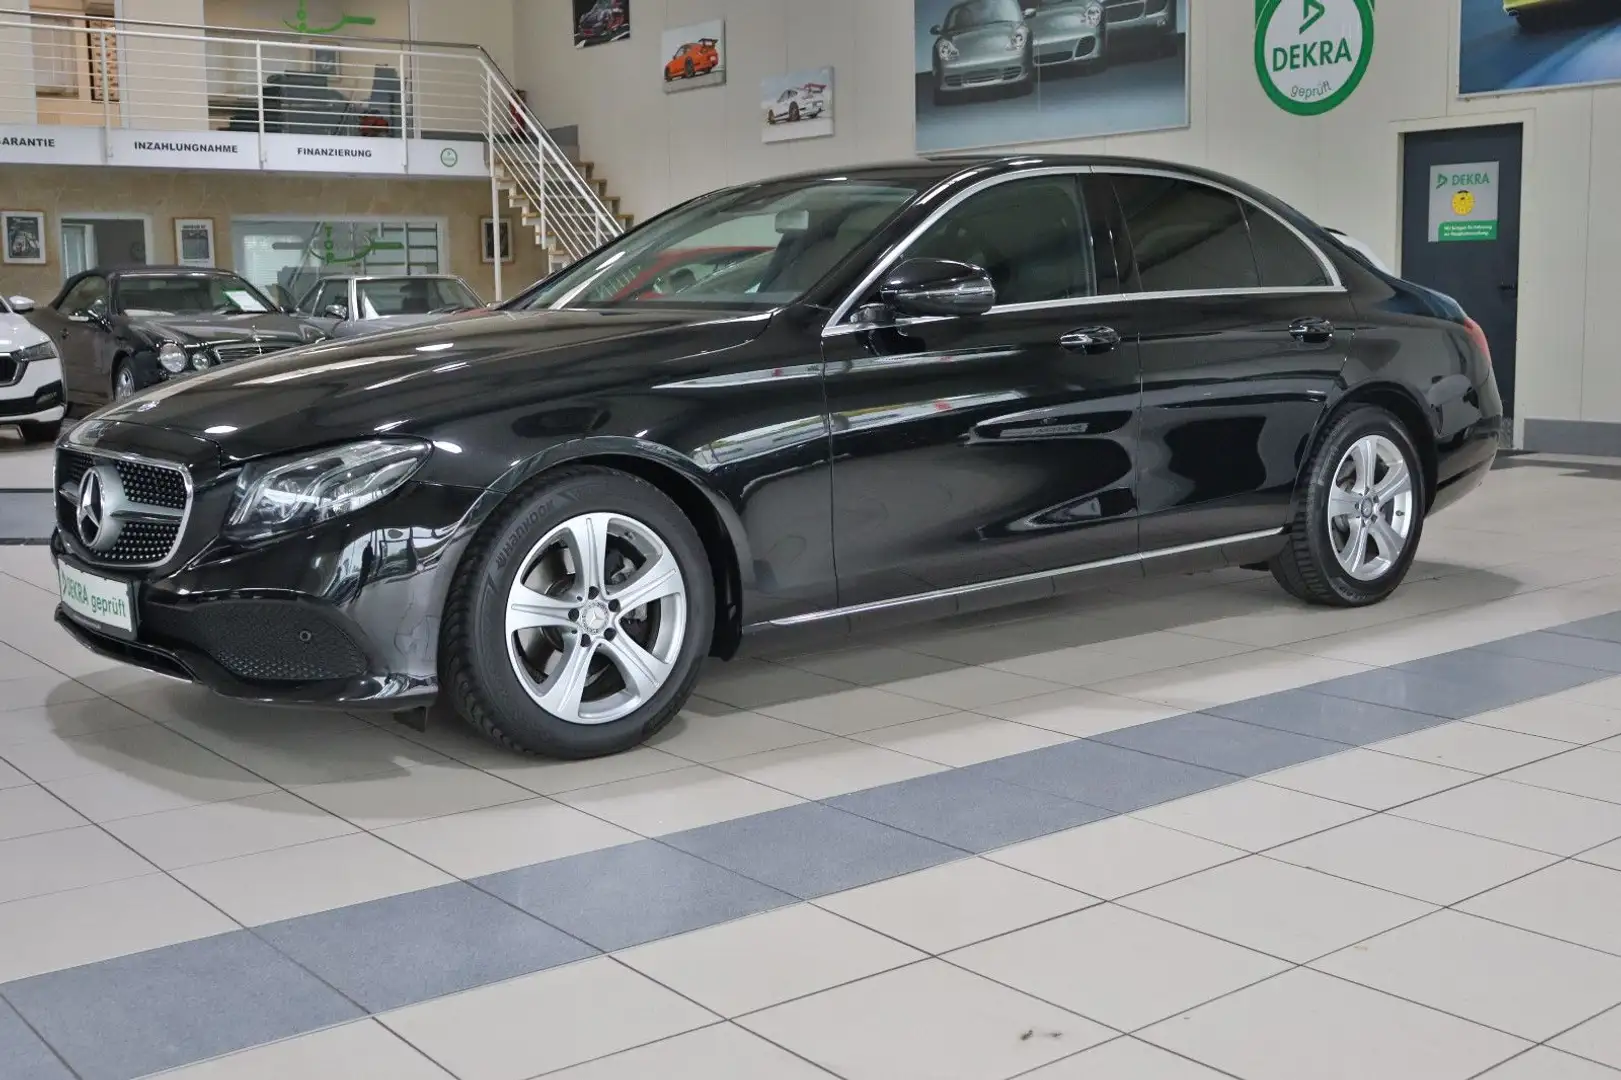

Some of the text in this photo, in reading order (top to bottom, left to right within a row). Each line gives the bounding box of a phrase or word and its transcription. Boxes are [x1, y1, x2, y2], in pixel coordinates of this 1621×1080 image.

[1272, 37, 1352, 72] DEKRA
[1290, 80, 1332, 100] geprüft
[0, 137, 55, 147] ARANTIE
[134, 141, 238, 153] INZAHLUNGNAHME
[297, 147, 372, 158] FINANZIERUNG
[1451, 172, 1490, 186] DEKRA
[91, 595, 126, 618] geprüft
